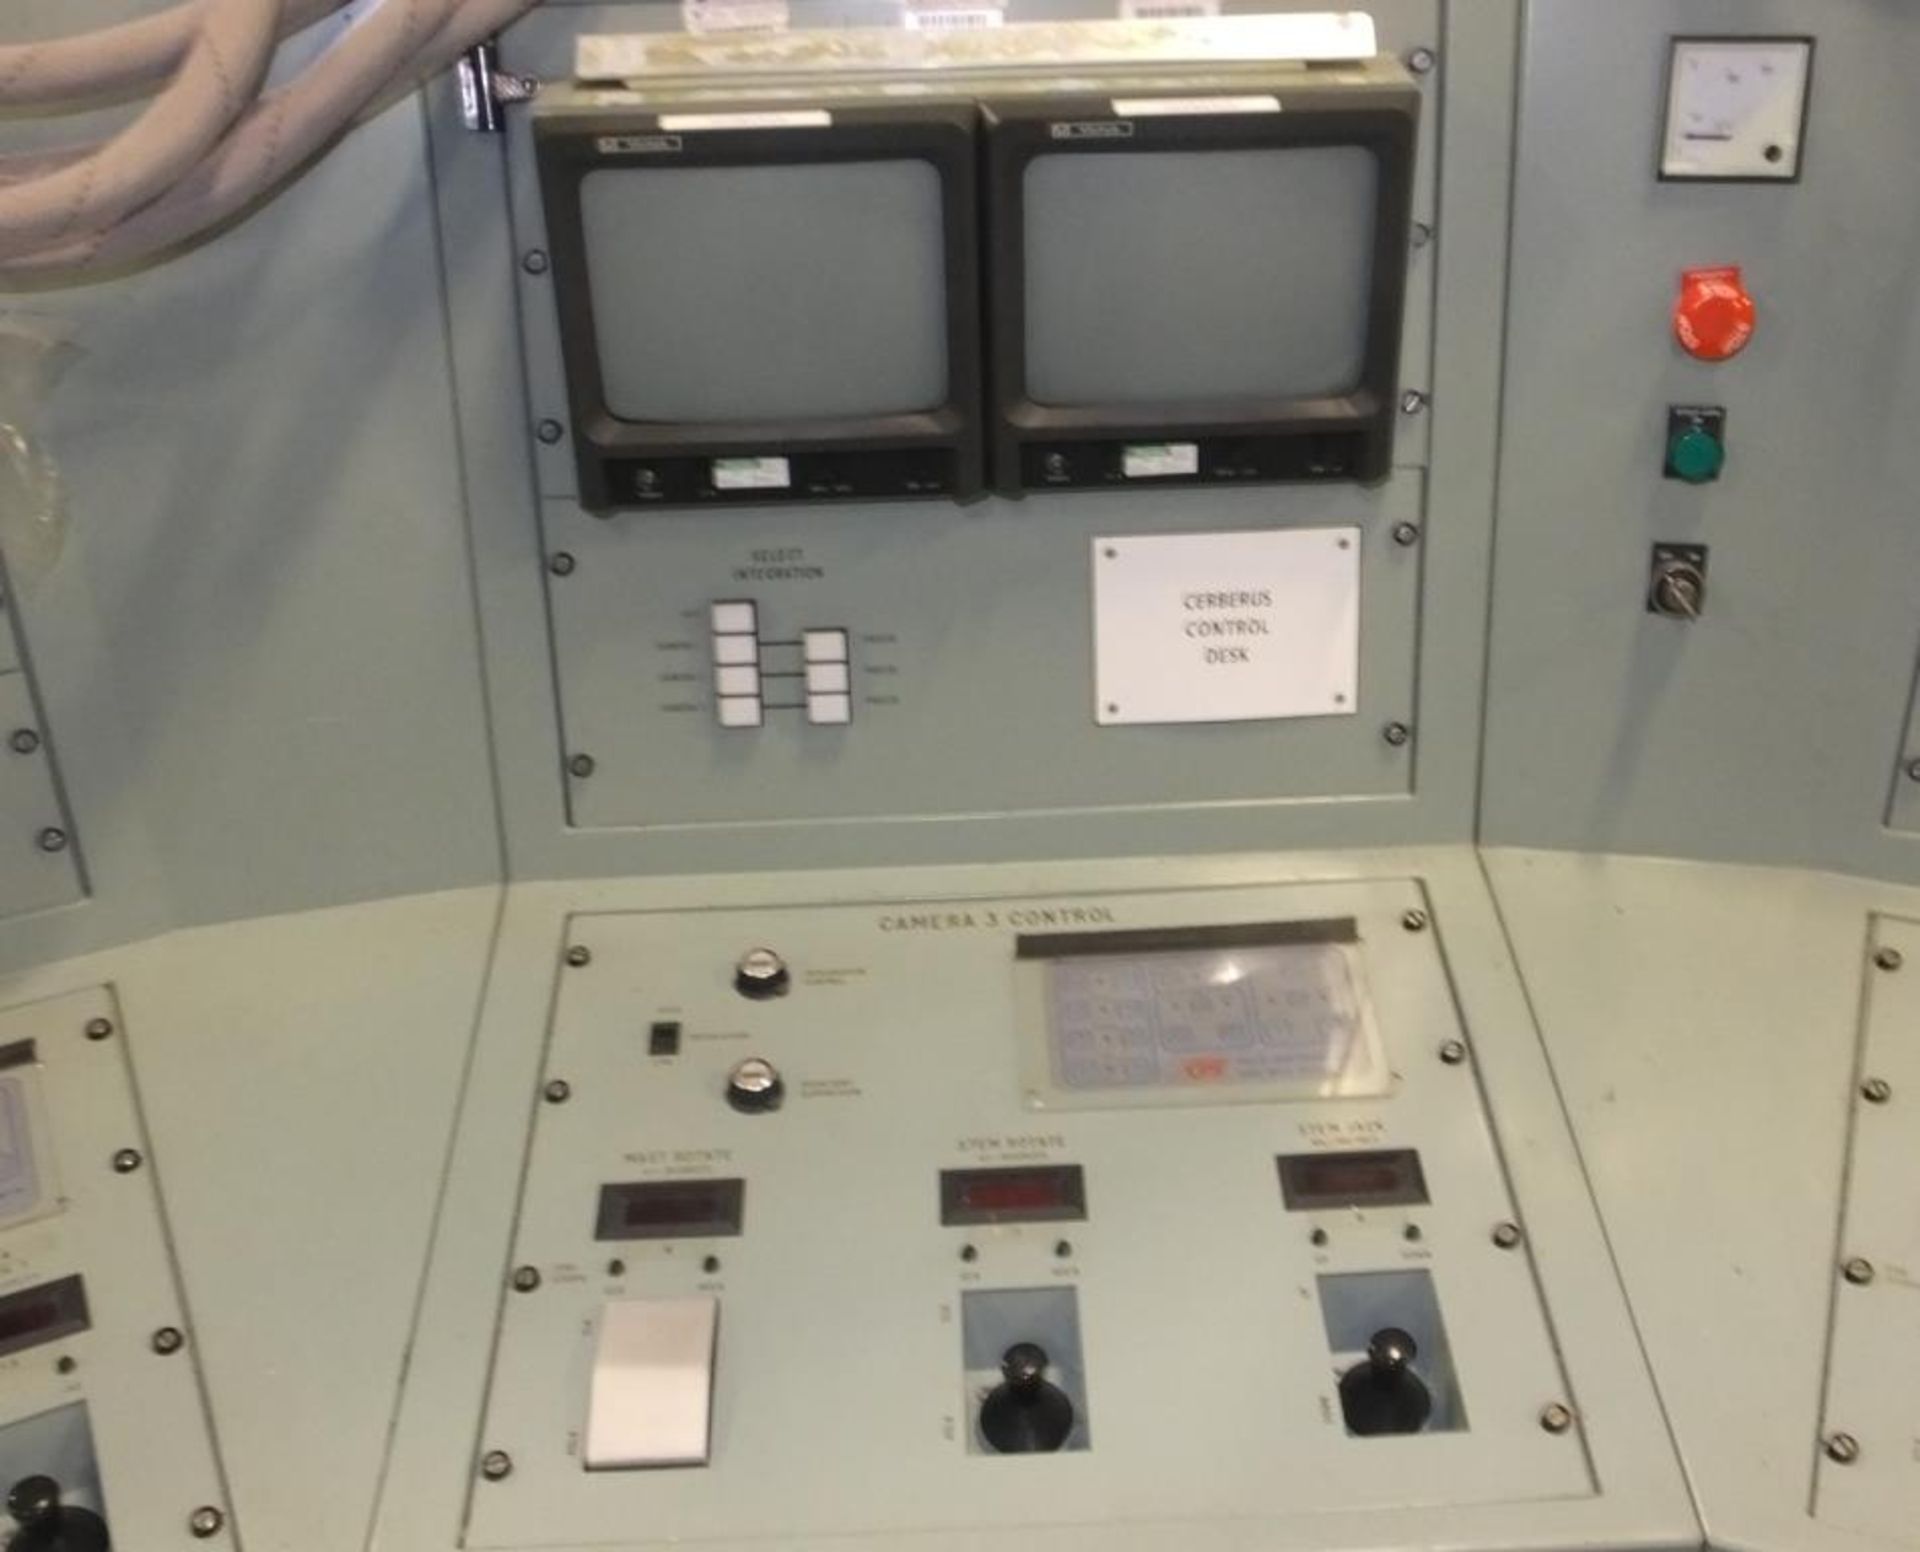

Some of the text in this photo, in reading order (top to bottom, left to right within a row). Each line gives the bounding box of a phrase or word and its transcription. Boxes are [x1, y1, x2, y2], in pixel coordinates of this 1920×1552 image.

[750, 548, 803, 562] SELECT
[731, 564, 825, 580] INTEGRATION
[1183, 591, 1273, 610] CERBERUS
[1184, 618, 1270, 637] CONTROL
[1204, 647, 1251, 664] DESK
[879, 913, 975, 932] CAMERA
[1006, 907, 1115, 927] CONTROL
[673, 1148, 734, 1163] ROTATE
